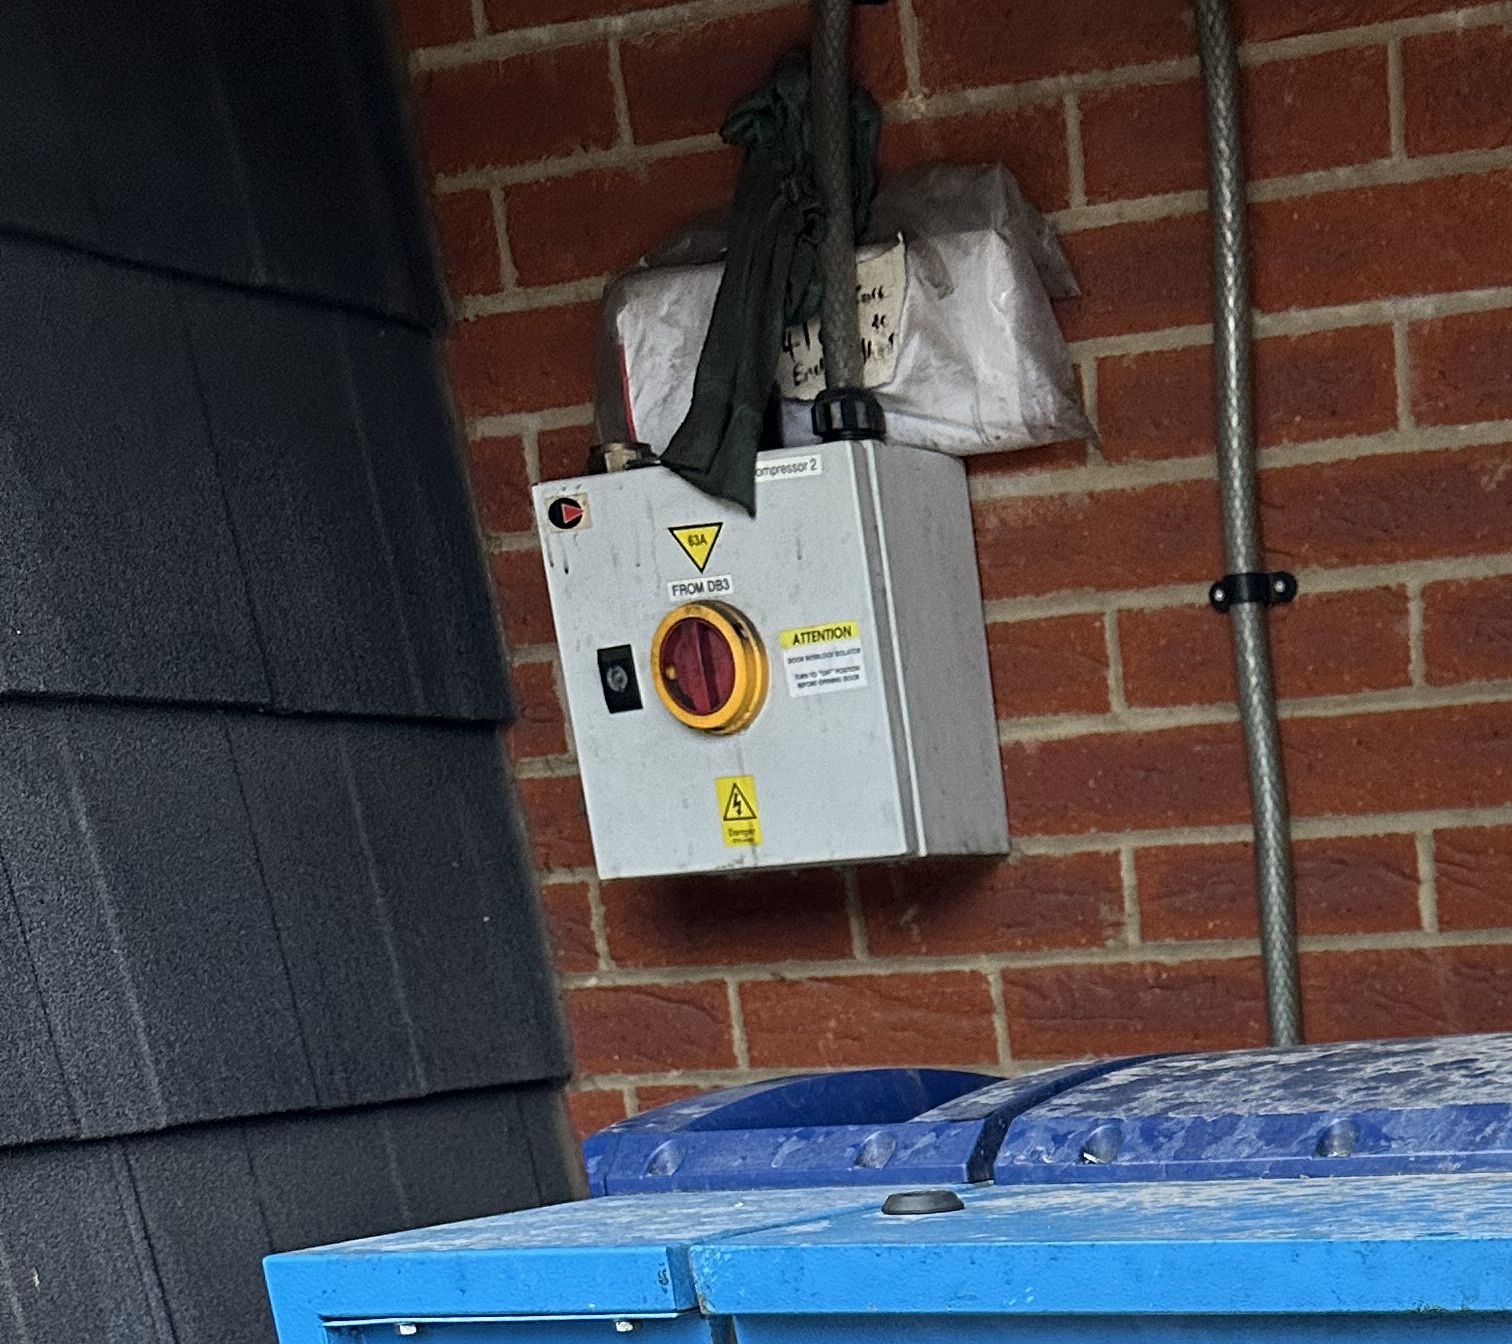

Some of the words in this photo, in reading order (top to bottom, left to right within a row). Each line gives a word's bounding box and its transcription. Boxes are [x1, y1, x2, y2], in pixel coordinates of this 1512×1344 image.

[755, 462, 808, 477] ompressor
[810, 458, 818, 471] 2
[688, 534, 708, 547] 63A
[672, 582, 704, 597] FROM
[707, 578, 730, 592] DB3
[793, 625, 852, 645] ATTENTION
